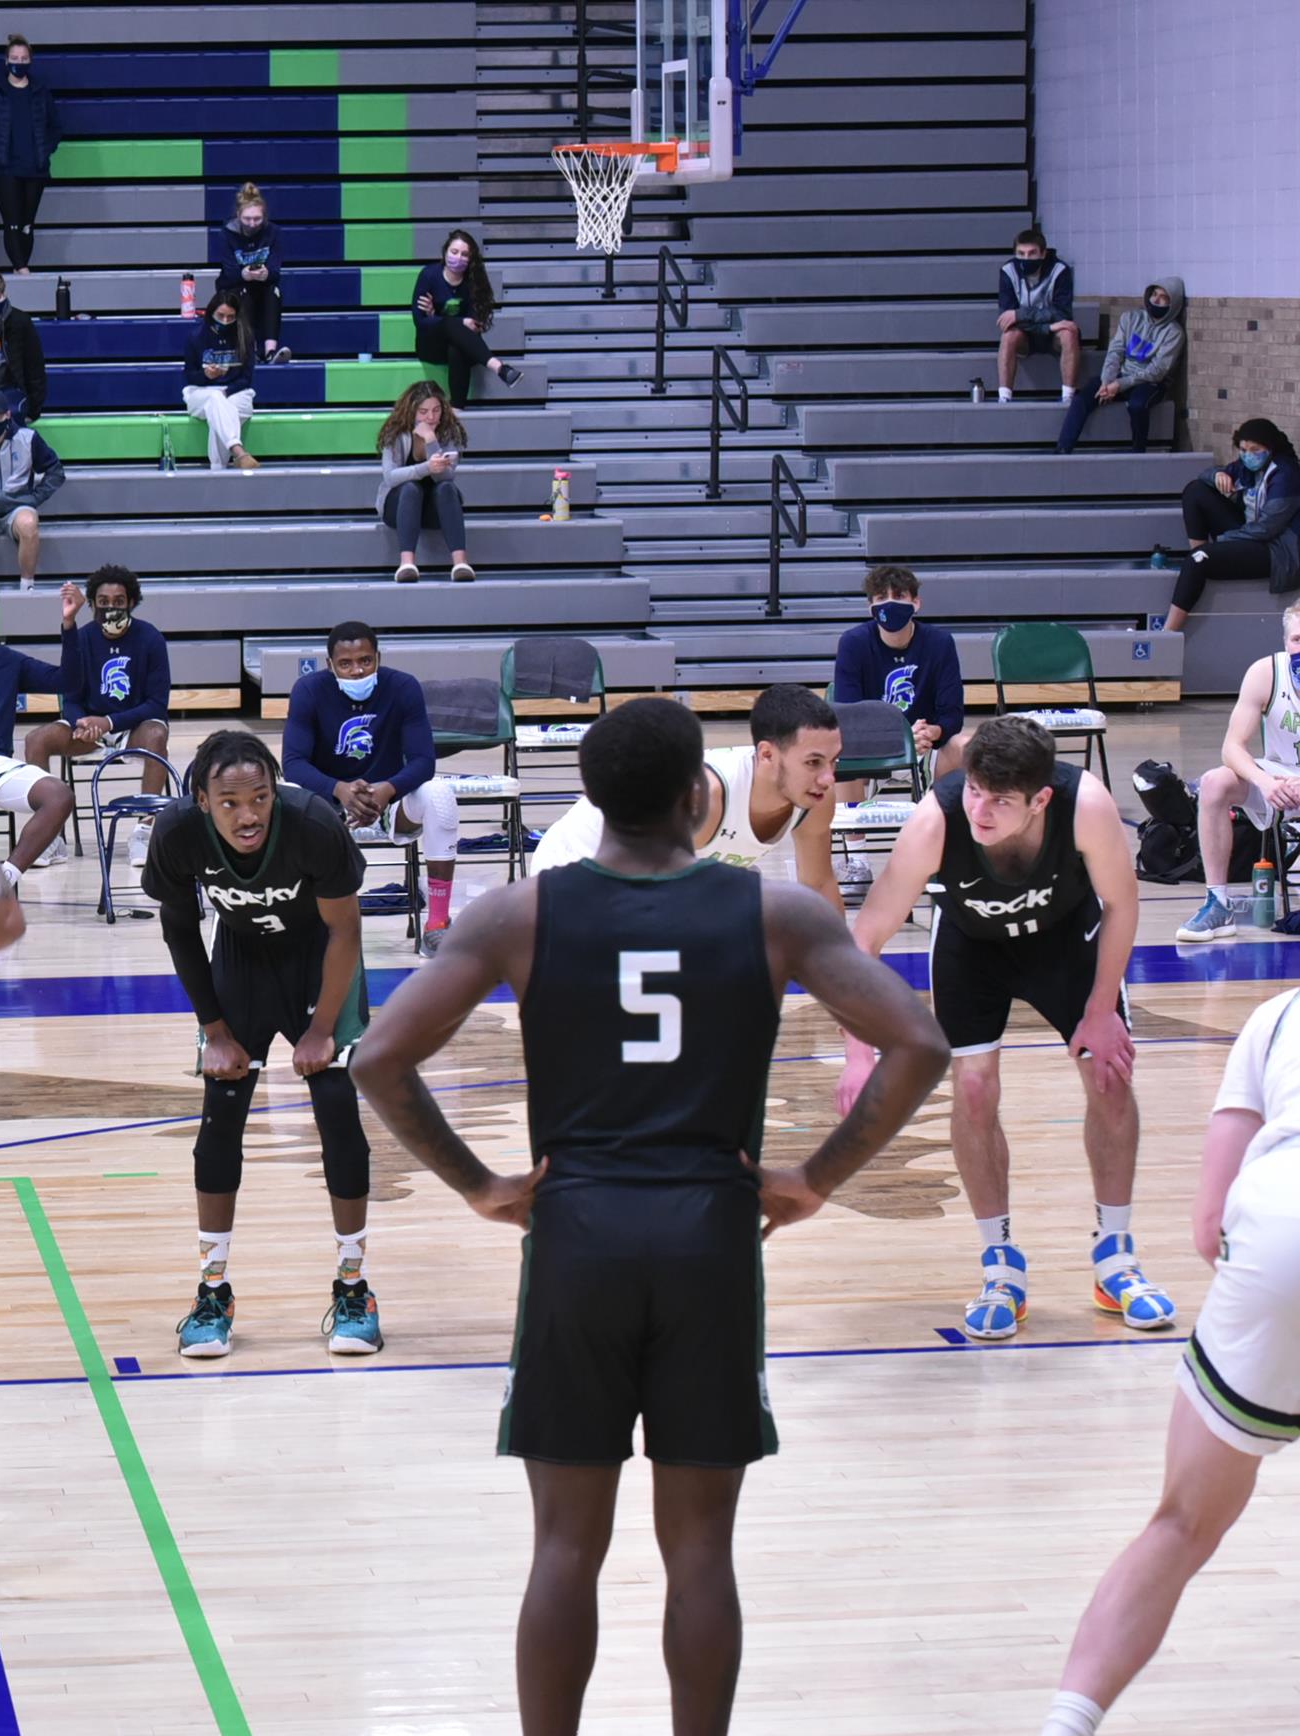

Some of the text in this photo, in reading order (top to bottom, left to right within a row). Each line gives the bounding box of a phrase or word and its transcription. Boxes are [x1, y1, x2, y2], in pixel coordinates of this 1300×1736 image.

[207, 879, 302, 912] ROCKY
[963, 884, 1054, 919] ROCK
[1004, 918, 1039, 938] 11
[619, 950, 682, 1063] 5
